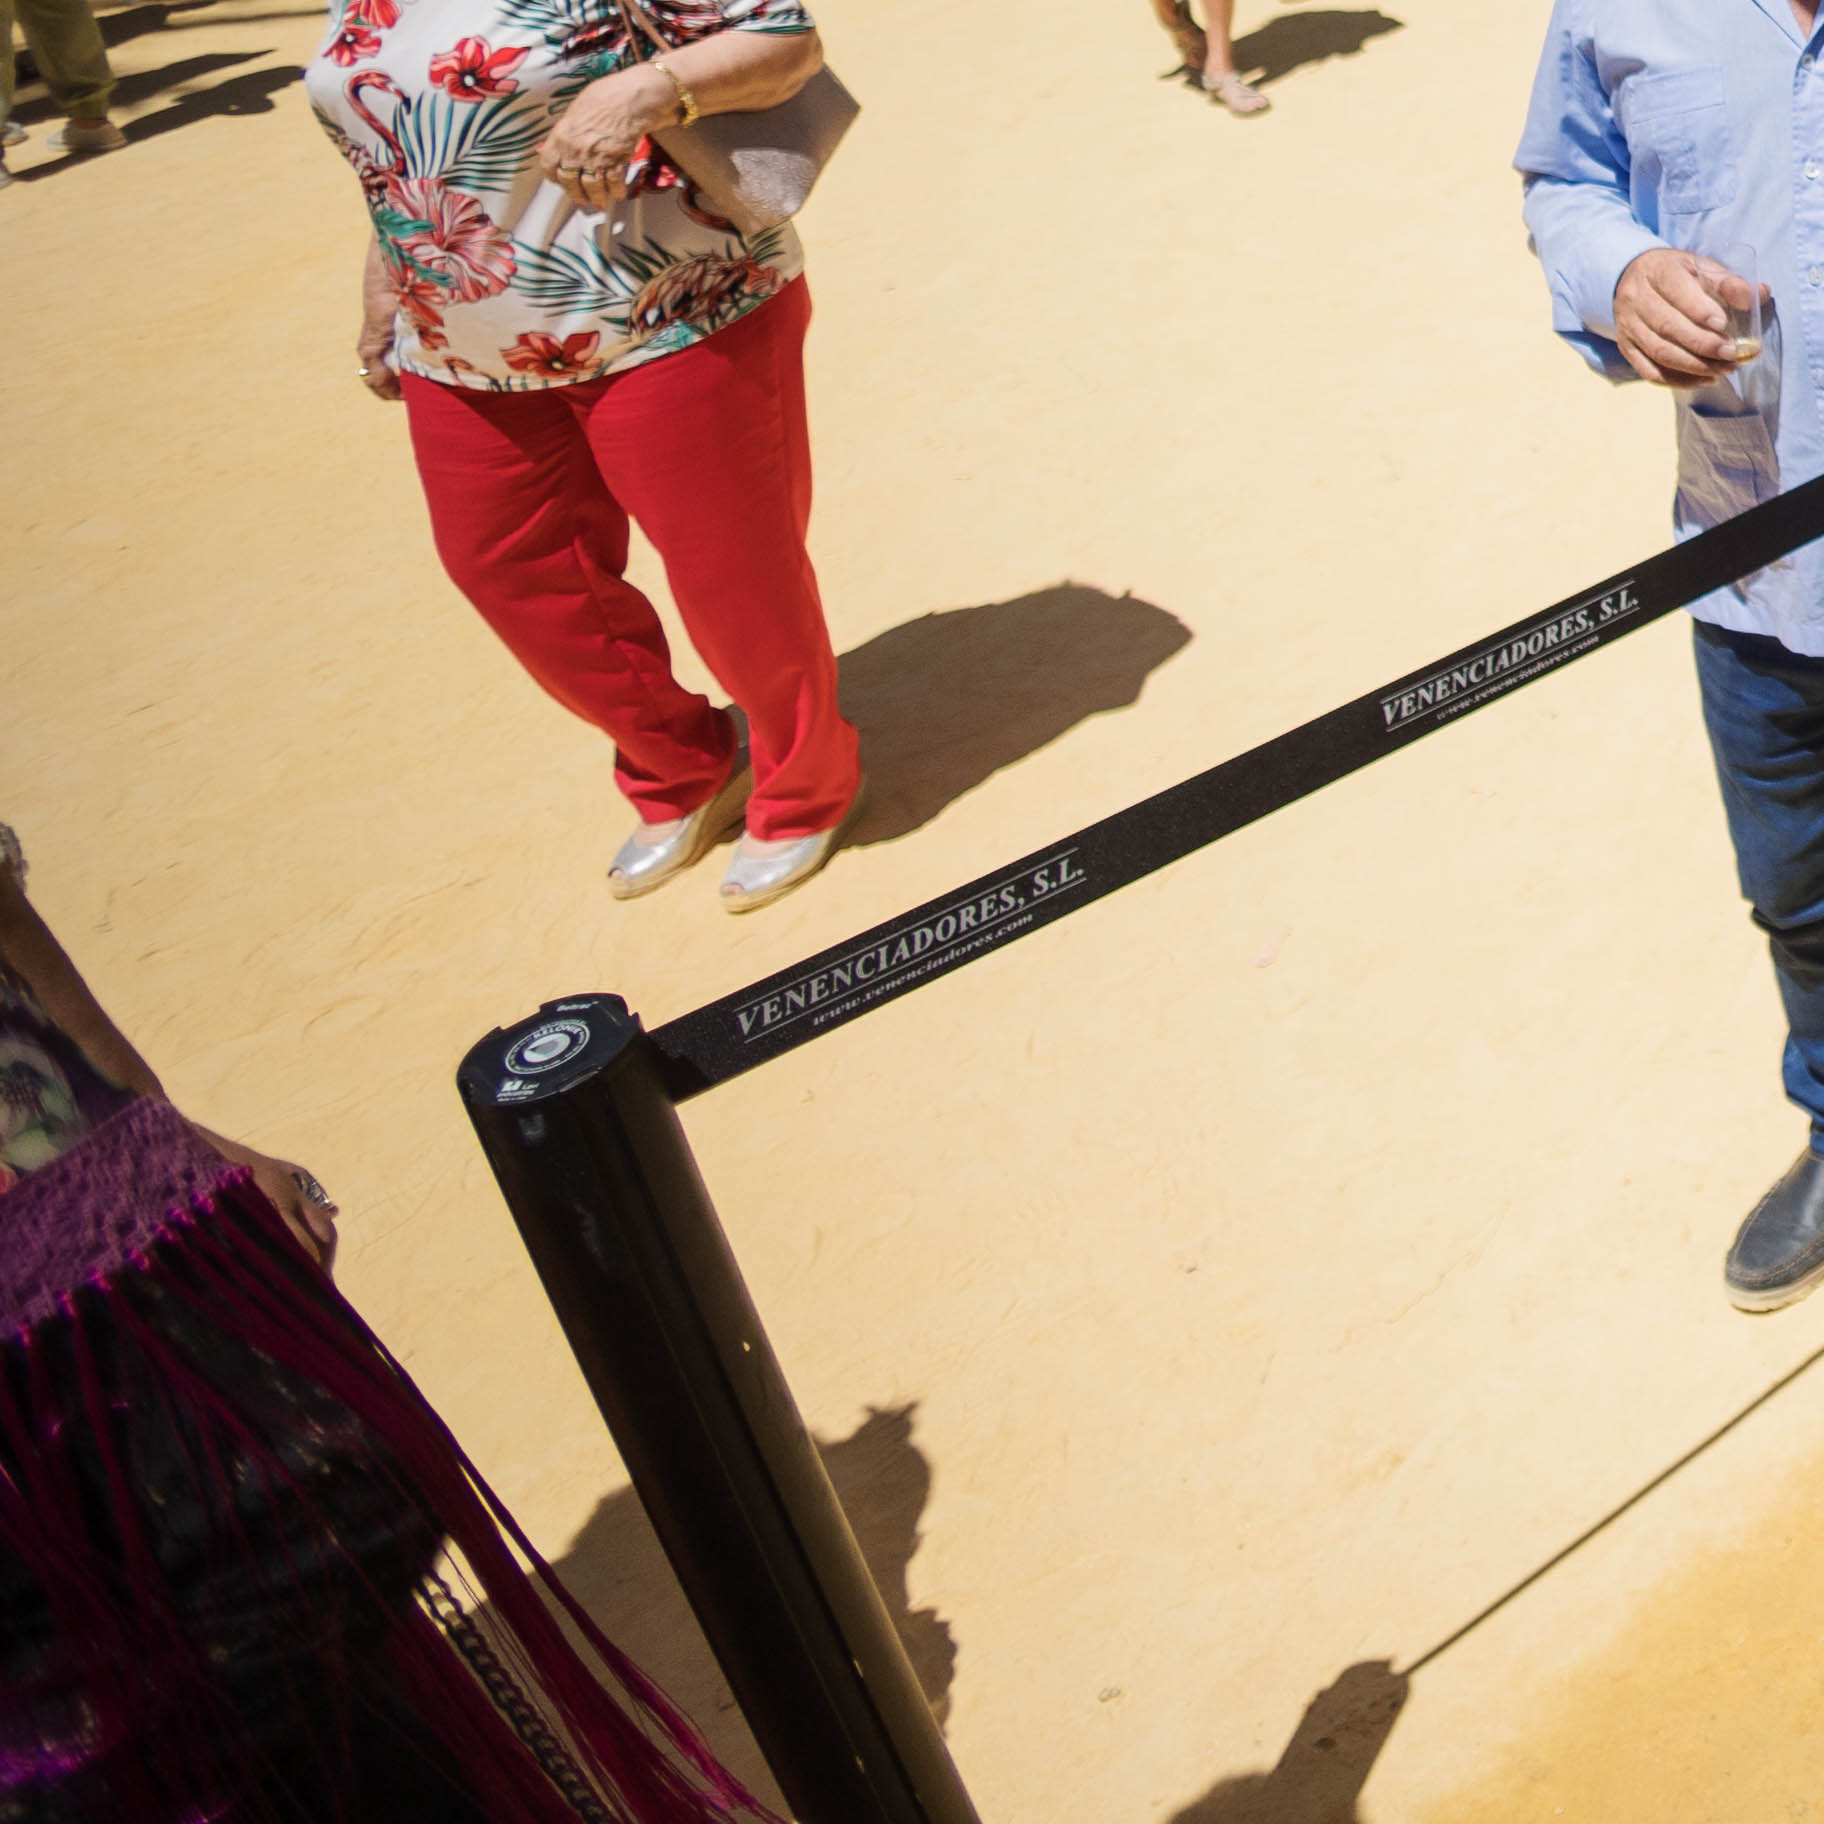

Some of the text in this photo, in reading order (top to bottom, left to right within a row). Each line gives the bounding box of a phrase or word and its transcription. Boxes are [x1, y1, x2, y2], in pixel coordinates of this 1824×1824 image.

[1382, 588, 1640, 726] VENENCIADORES, S.L.
[736, 857, 1086, 1038] VENENCIADORES, S.L.
[811, 912, 1035, 1026] www.venenciadores.com
